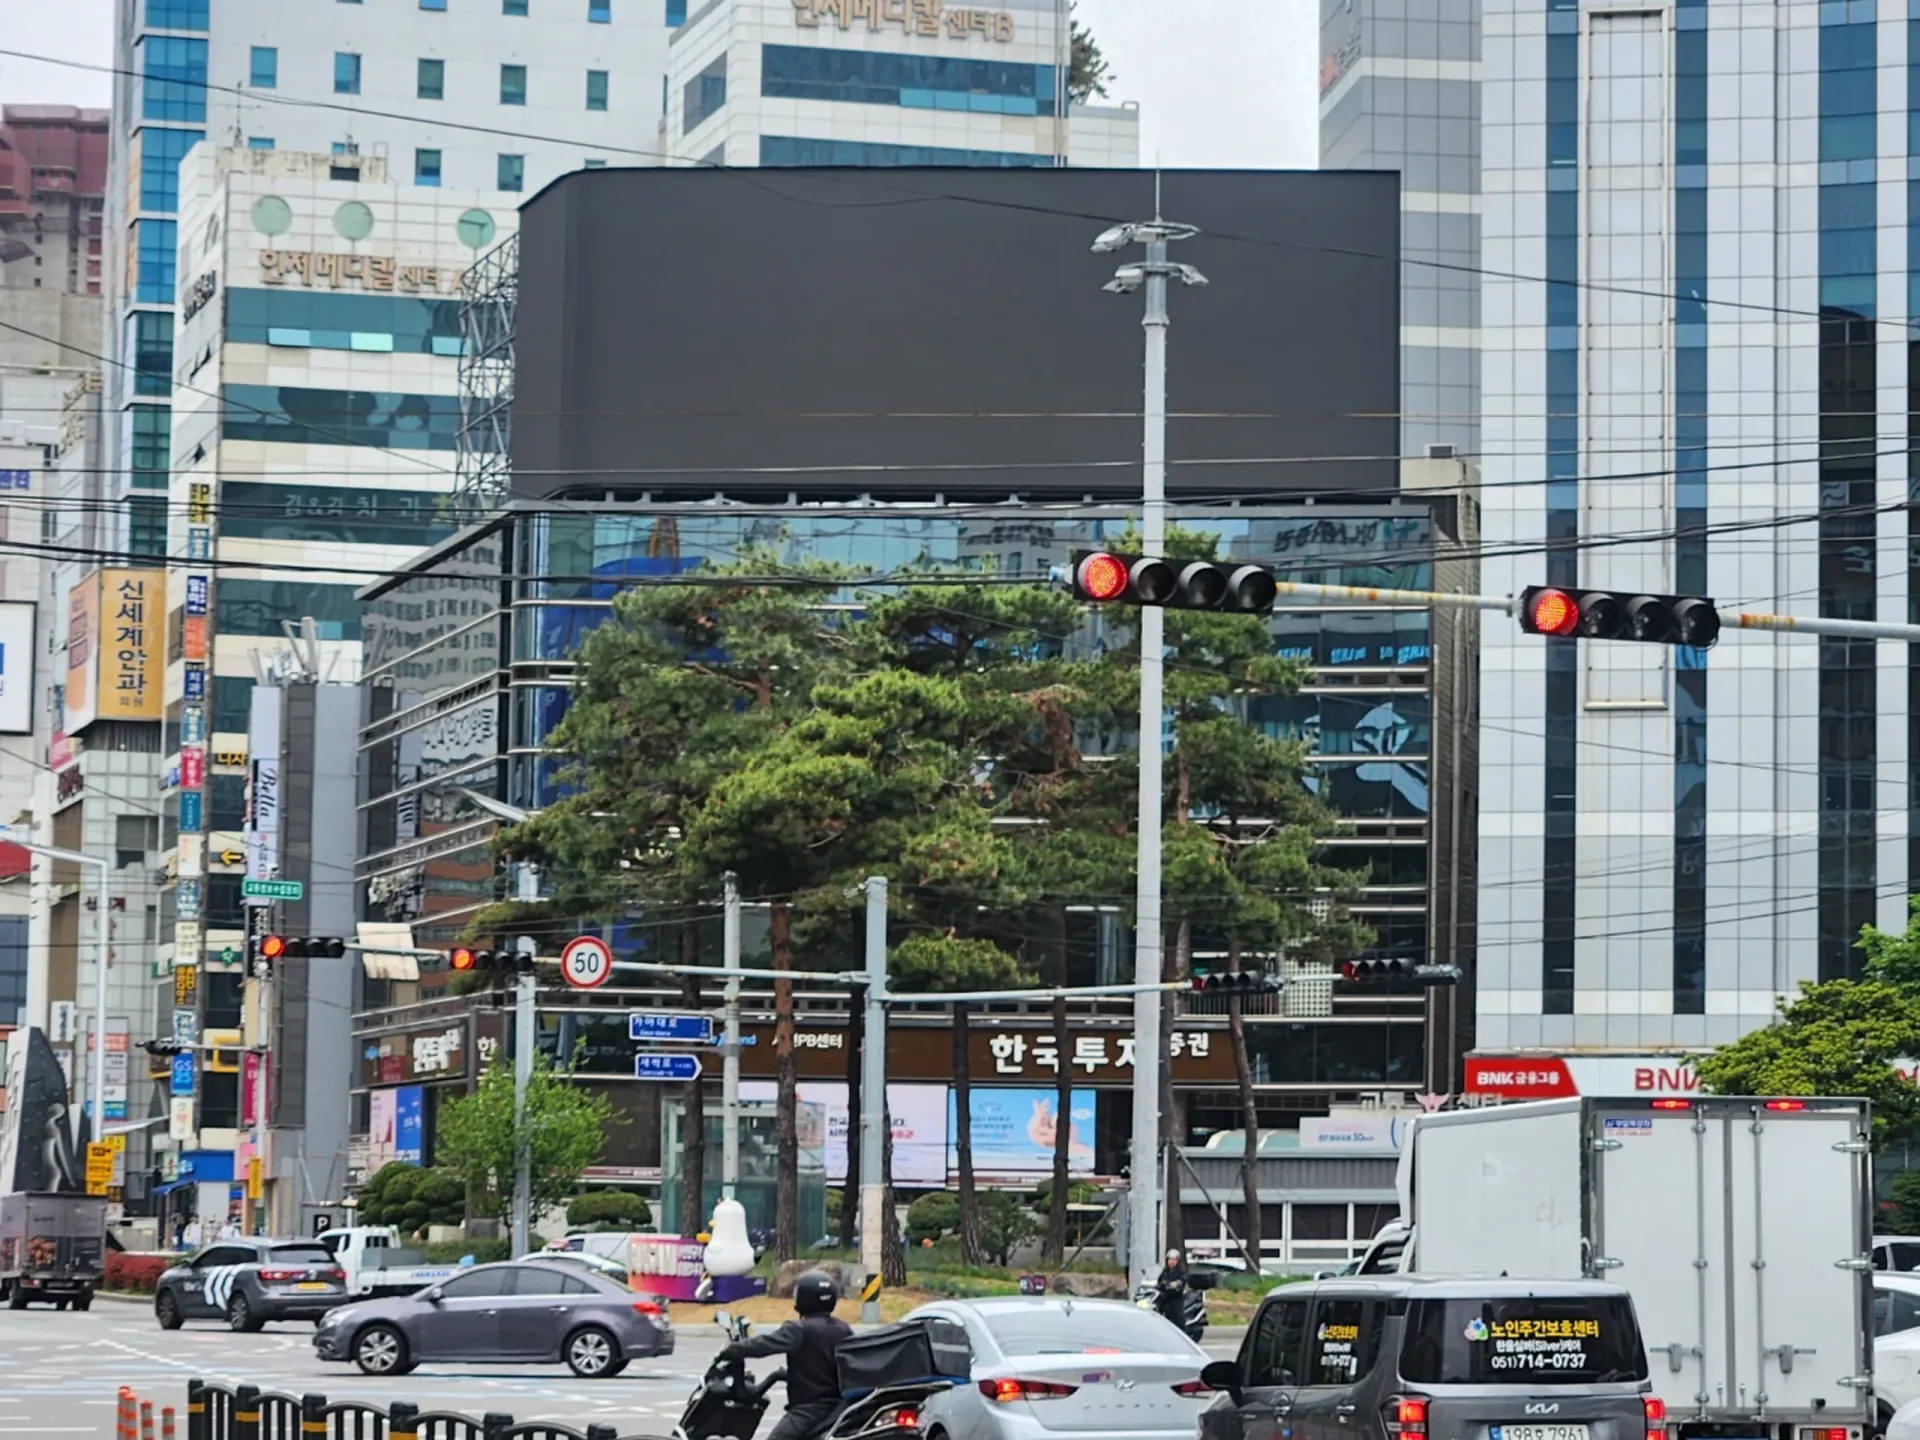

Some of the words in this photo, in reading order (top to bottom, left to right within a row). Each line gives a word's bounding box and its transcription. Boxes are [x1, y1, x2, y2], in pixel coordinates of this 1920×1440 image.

[260, 249, 396, 291] 인제메디칼
[115, 579, 148, 695] 신세계안과
[259, 767, 277, 817] Bella
[575, 953, 599, 973] 50
[633, 1015, 678, 1029] 가야대로
[317, 1218, 328, 1230] P
[1491, 1319, 1600, 1338] 노인주간보호센터
[1491, 1353, 1587, 1369] 051)714-0737
[1524, 1403, 1559, 1414] KIA
